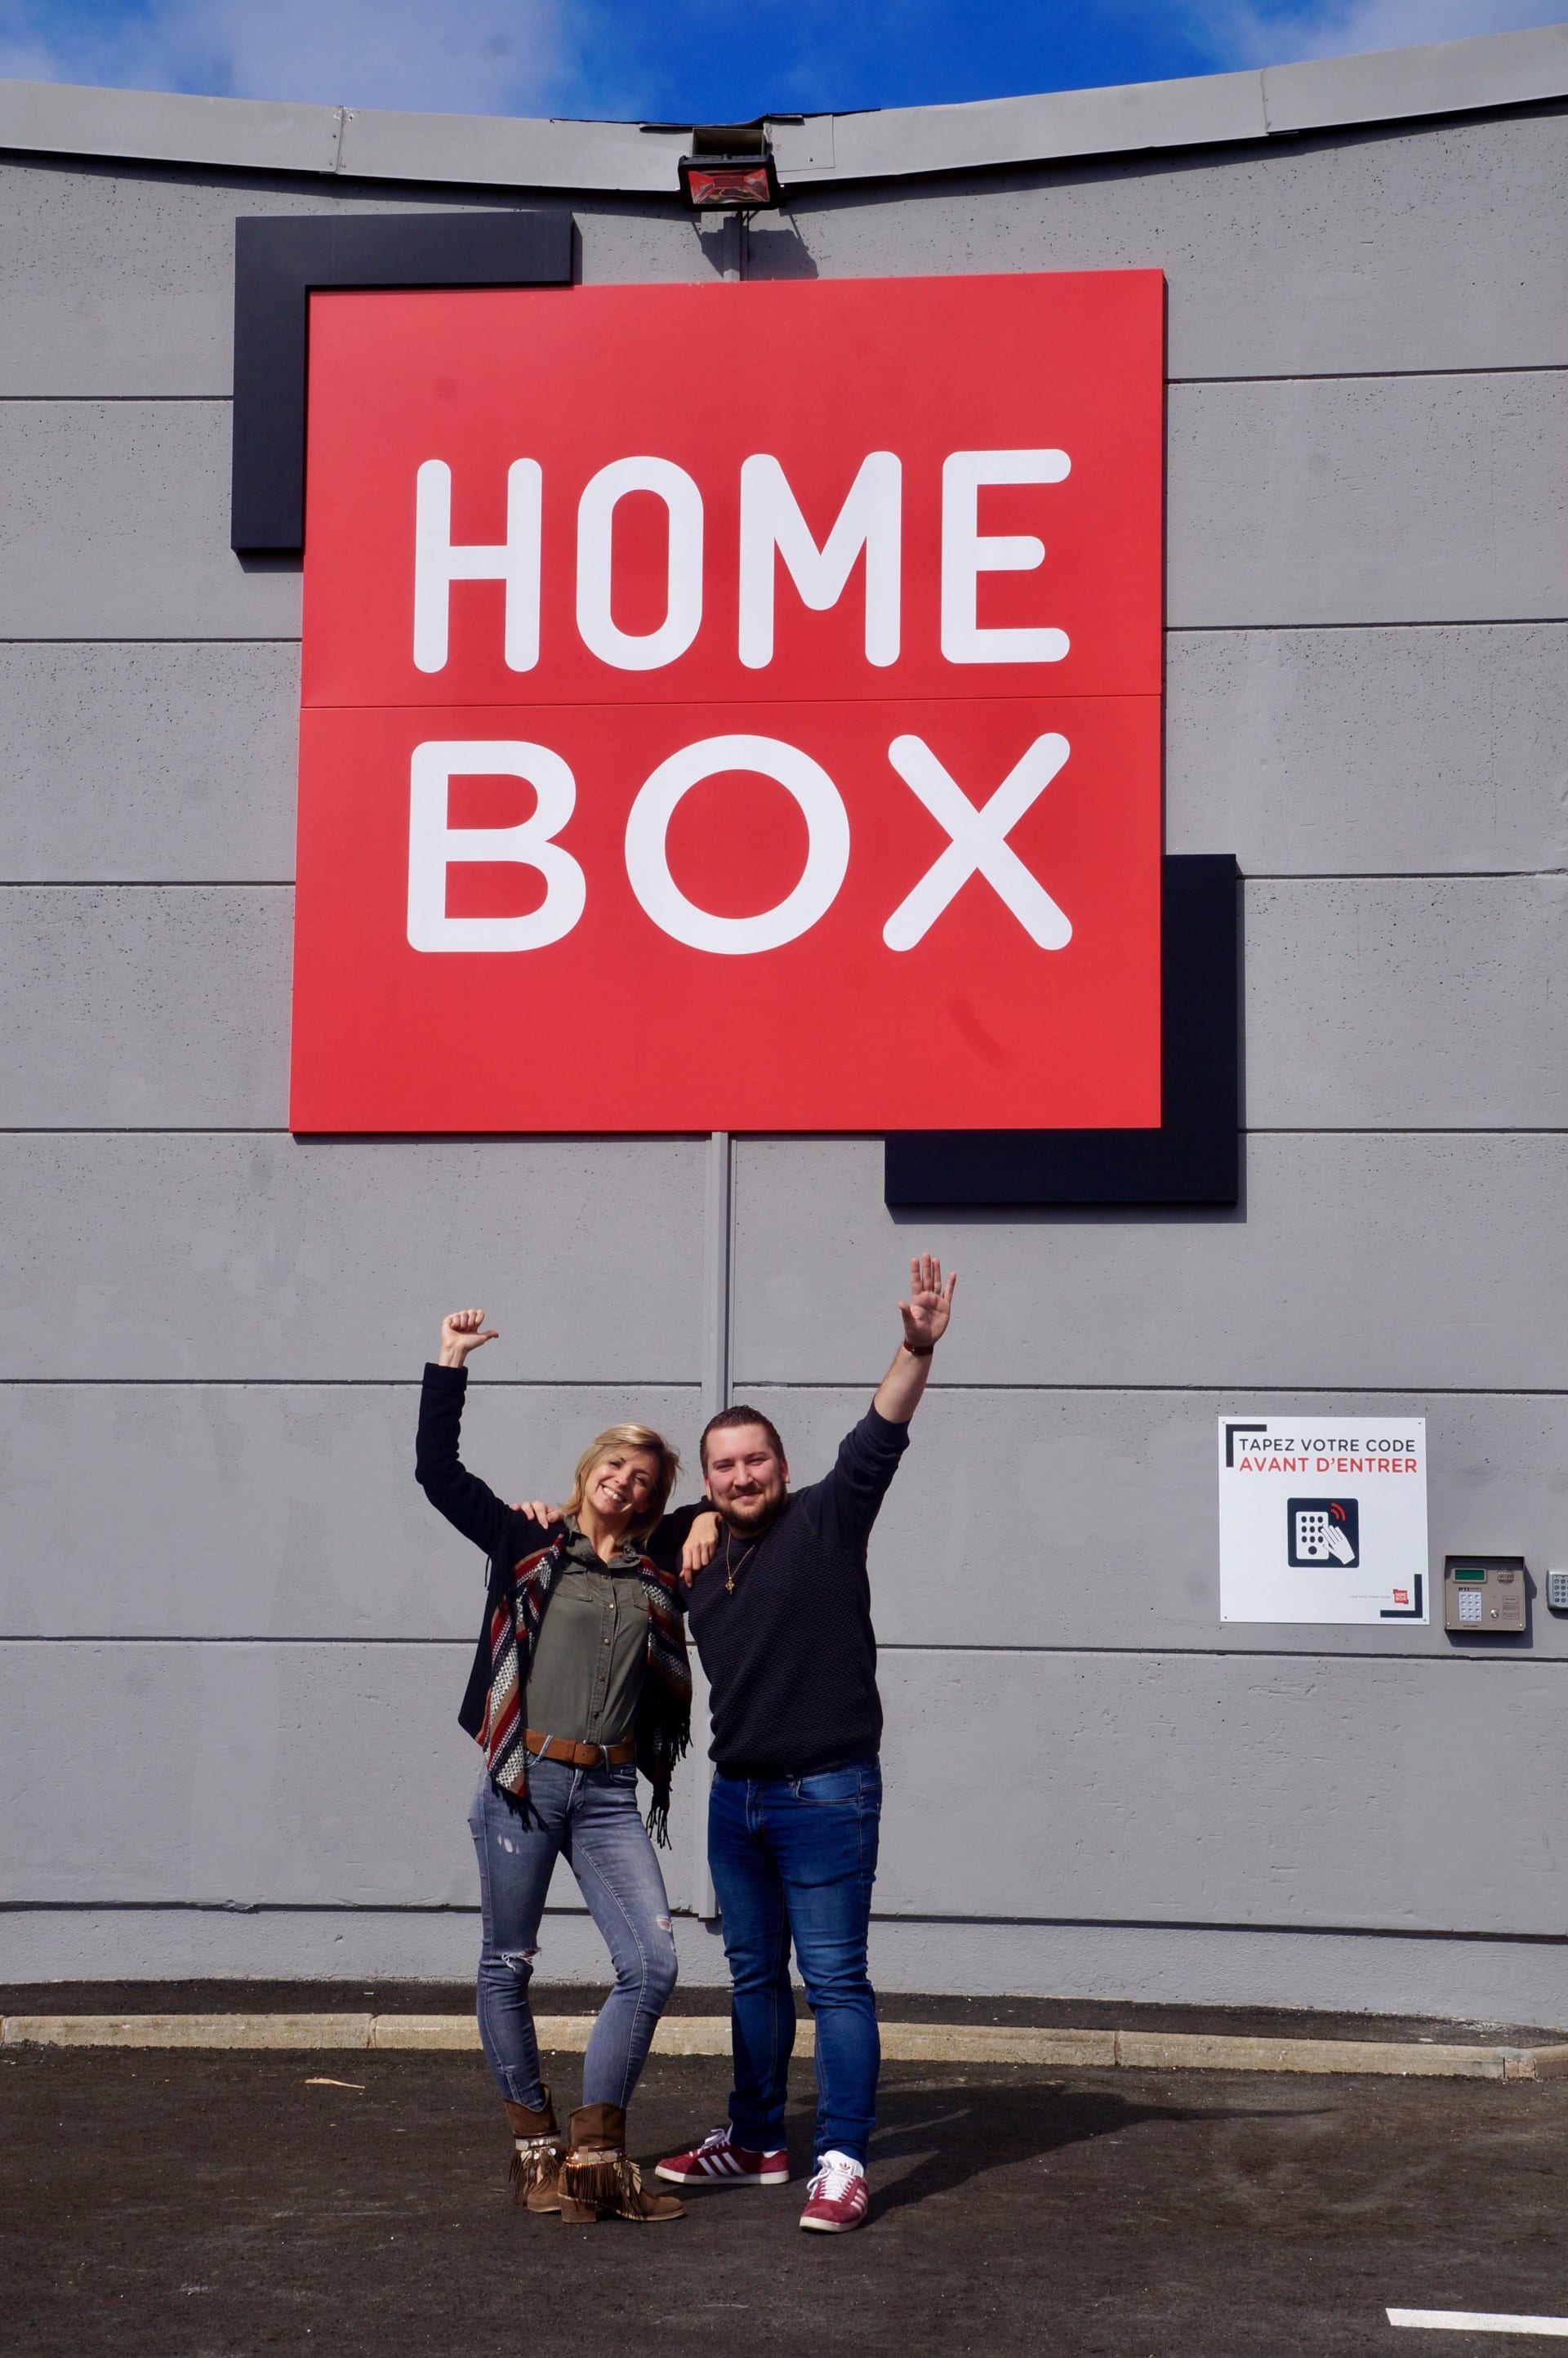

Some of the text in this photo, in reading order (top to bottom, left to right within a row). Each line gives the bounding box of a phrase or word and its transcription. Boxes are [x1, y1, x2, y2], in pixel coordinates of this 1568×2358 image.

[413, 449, 1071, 673] HOME
[407, 733, 1072, 954] BOX
[1239, 1438, 1415, 1452] TAPEZ VOTRE CODE
[1239, 1457, 1309, 1472] AVANT
